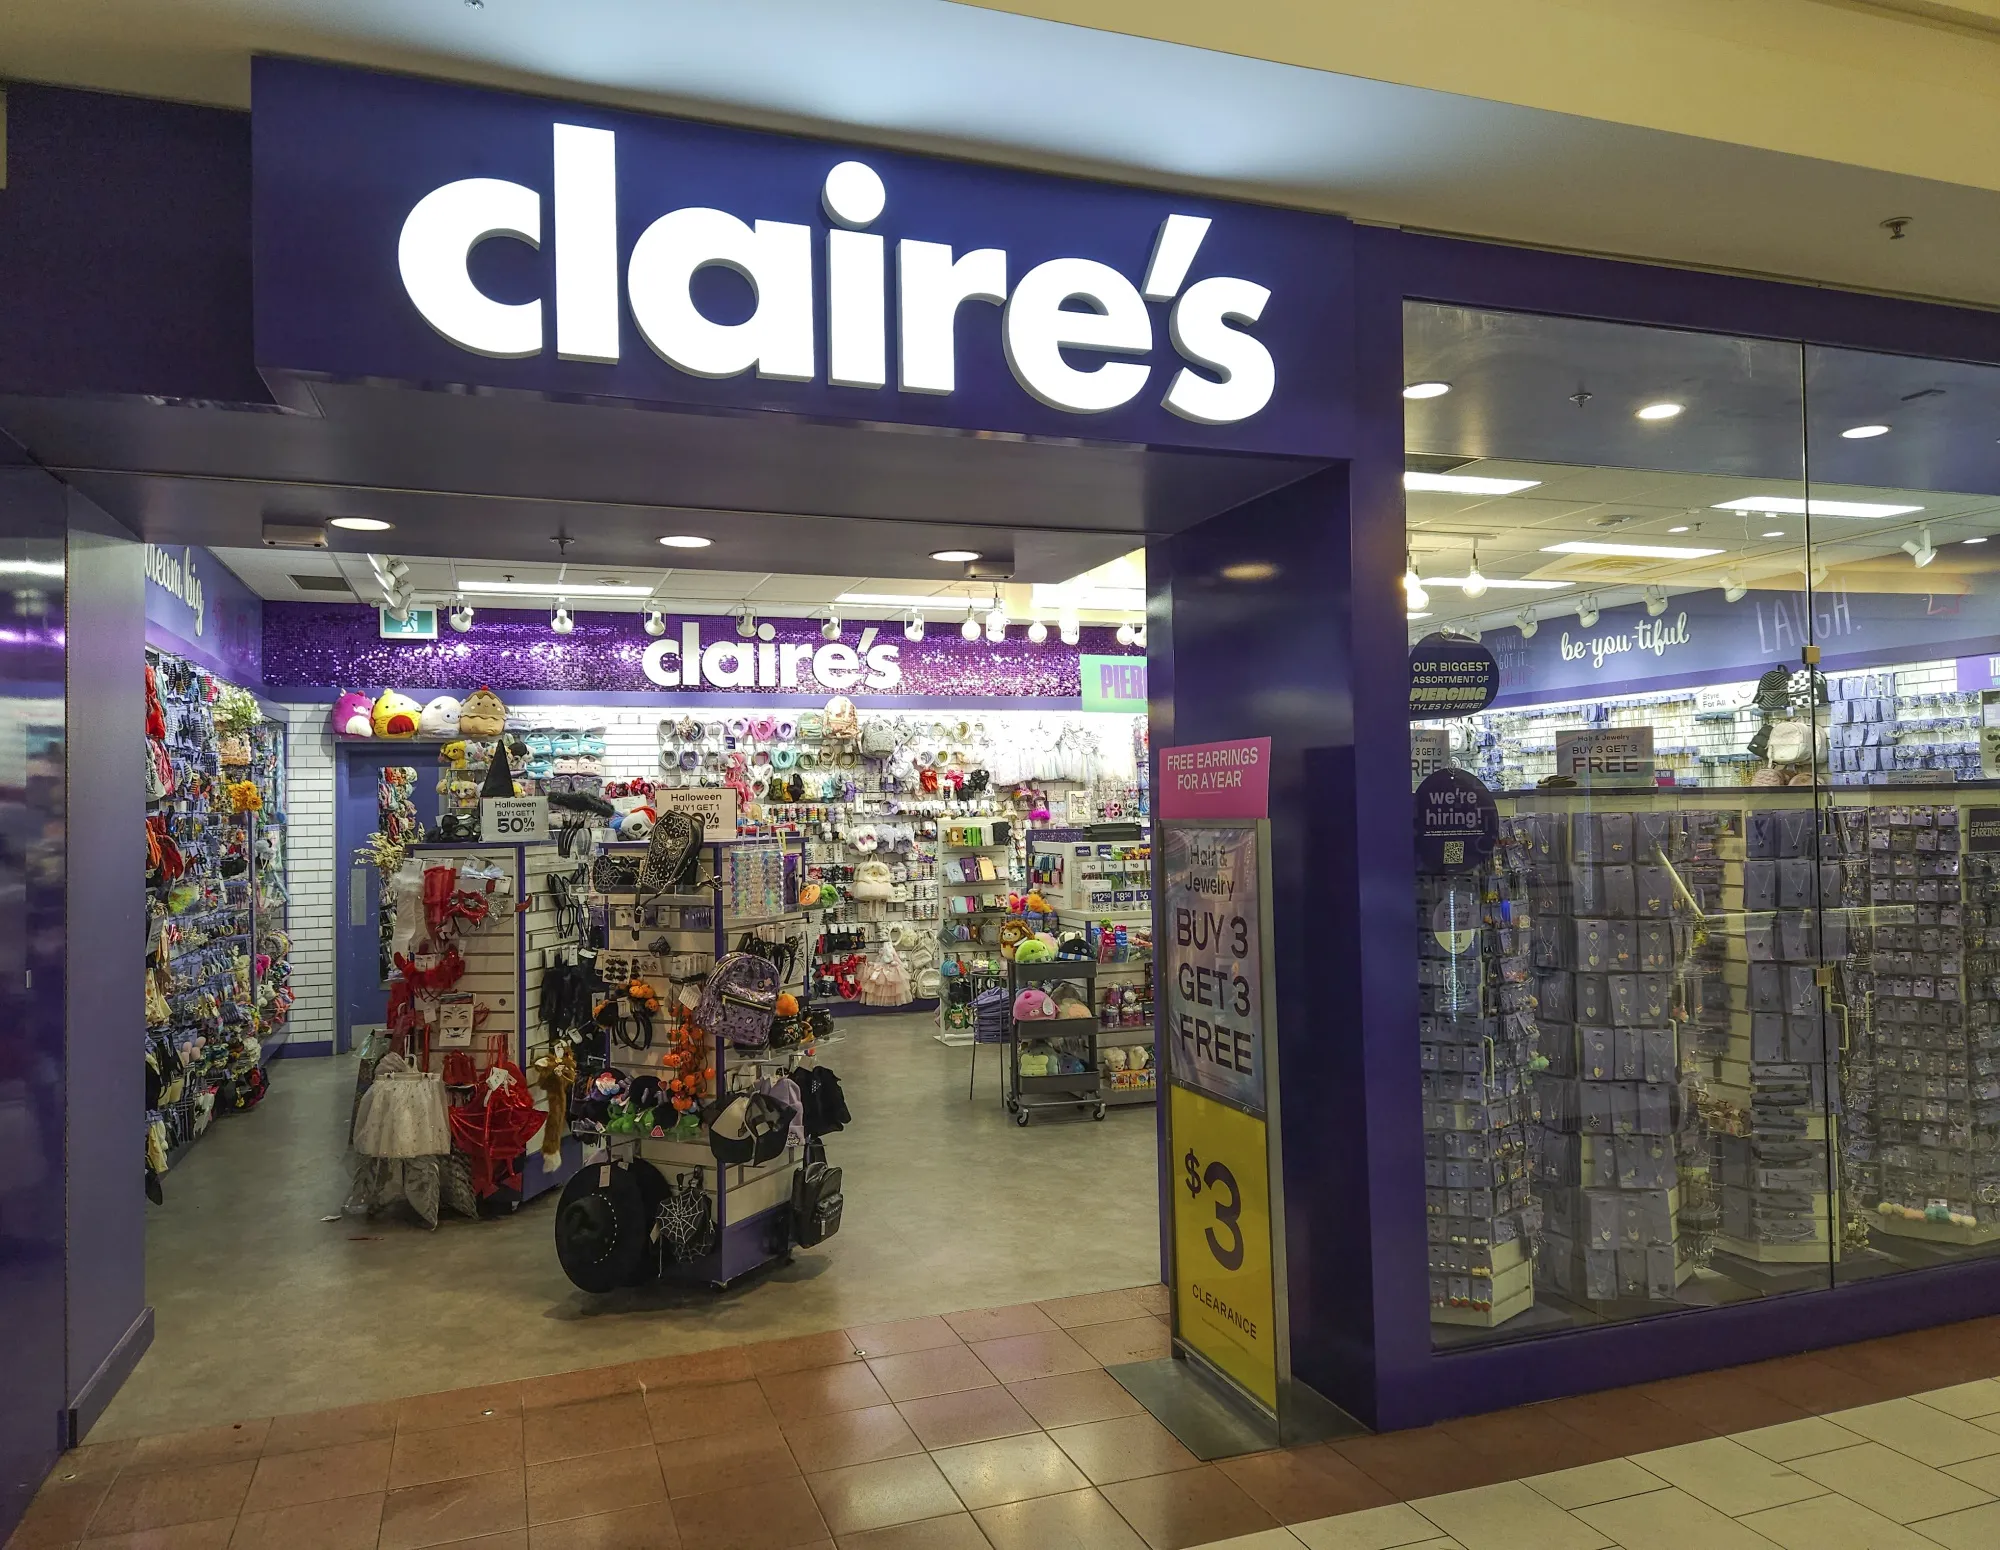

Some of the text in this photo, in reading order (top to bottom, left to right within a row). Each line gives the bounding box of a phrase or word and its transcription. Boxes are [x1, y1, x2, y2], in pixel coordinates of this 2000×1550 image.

[398, 122, 1276, 424] claire's
[185, 547, 204, 634] big
[641, 621, 901, 690] claire's
[1412, 661, 1490, 672] OUR BIGGEST
[1100, 664, 1147, 699] PIER
[1412, 675, 1489, 684] ASSORTMENT OF
[1410, 686, 1487, 701] PIERCING
[1453, 702, 1483, 710] HERE!
[1167, 746, 1258, 771] FREE EARRINGS
[1422, 747, 1436, 756] GET
[1572, 744, 1638, 754] BUY 3 GET 3
[1572, 755, 1638, 773] FREE
[1177, 773, 1199, 790] FOR
[1200, 772, 1209, 789] A
[670, 793, 722, 802] Halloween
[1429, 788, 1478, 805] we're
[673, 804, 690, 812] BUY
[696, 803, 714, 811] GET
[497, 817, 535, 833] 50%
[1425, 807, 1482, 829] hiring!
[1189, 844, 1228, 867] Hair &
[1185, 872, 1235, 901] Jewelry
[1176, 907, 1249, 959] BUY 3
[1178, 963, 1251, 1017] GET 3
[1179, 1012, 1253, 1077] FREE
[1191, 1283, 1257, 1341] CLEARANCE
